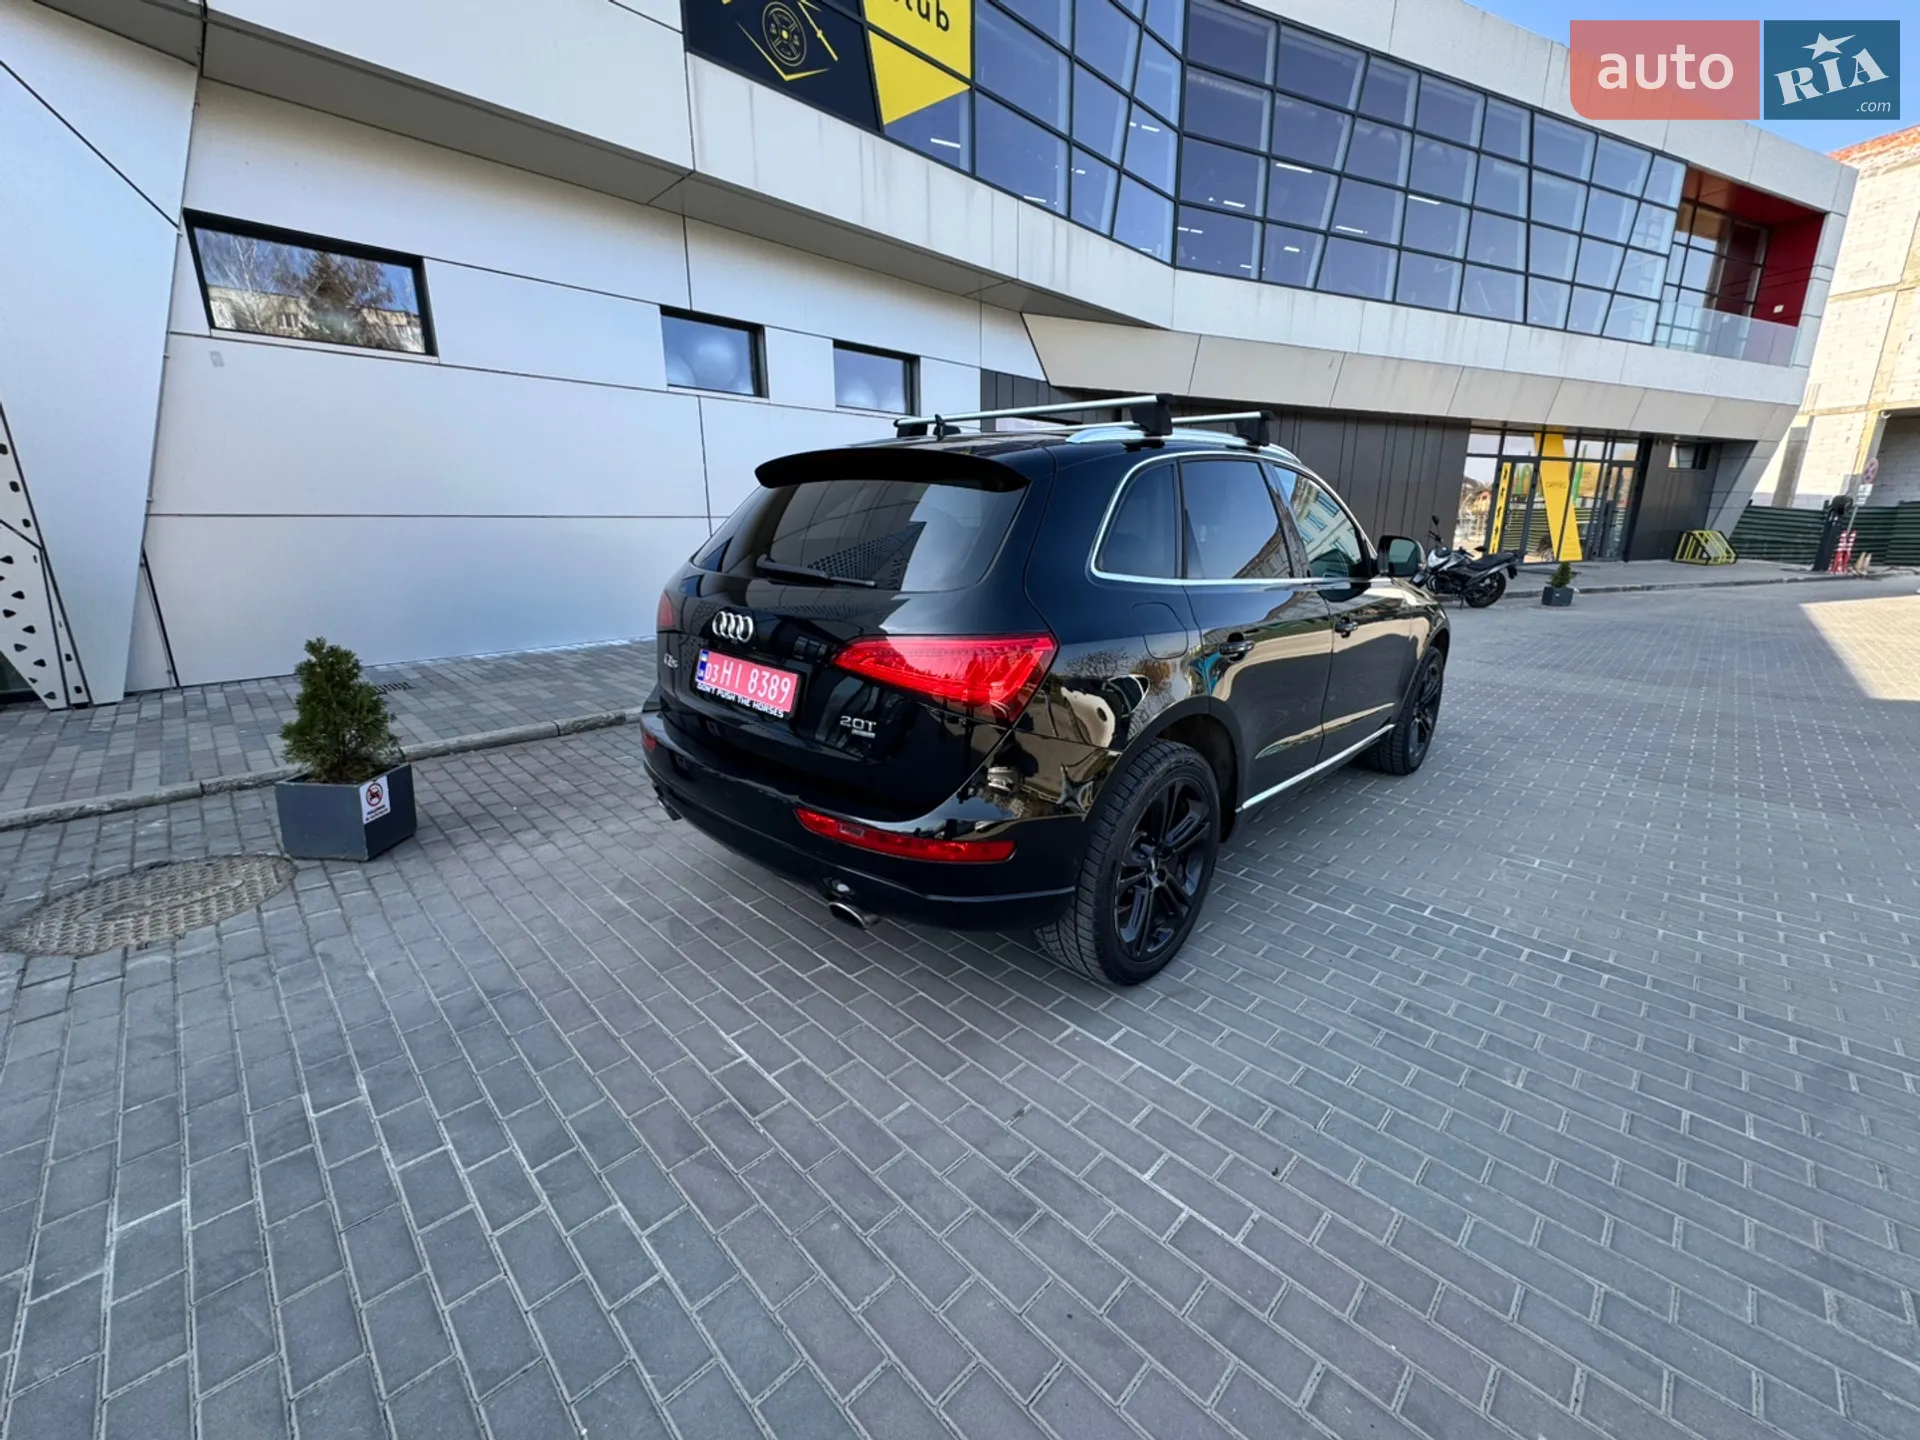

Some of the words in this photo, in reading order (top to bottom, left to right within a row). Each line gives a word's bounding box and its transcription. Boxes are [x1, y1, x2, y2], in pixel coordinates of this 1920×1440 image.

[748, 668, 791, 704] 8389
[716, 688, 736, 702] PUSH
[737, 695, 751, 707] THE
[752, 701, 785, 718] HORSES
